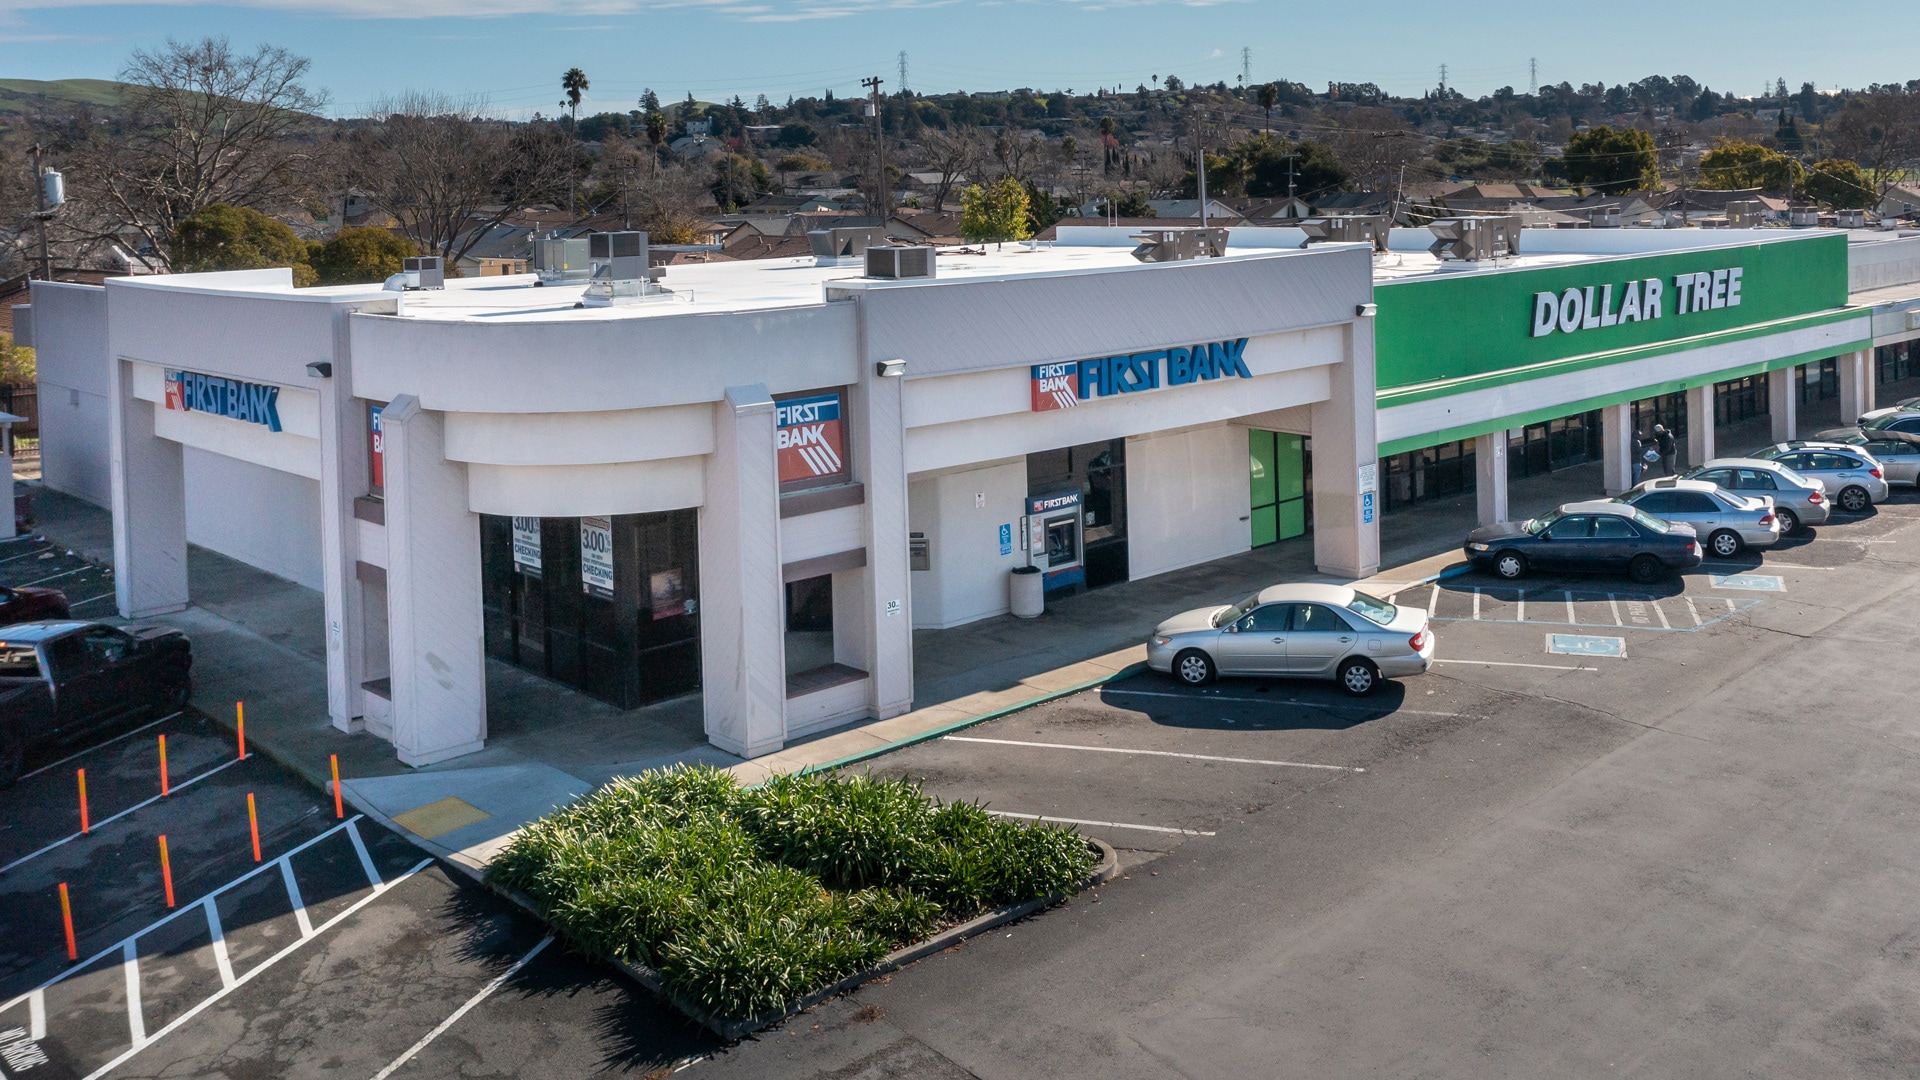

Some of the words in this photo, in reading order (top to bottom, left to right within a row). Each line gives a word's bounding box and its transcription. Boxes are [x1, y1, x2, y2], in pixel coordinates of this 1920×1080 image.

[1531, 278, 1664, 337] DOLLAR
[1673, 267, 1743, 314] TREE
[1039, 361, 1075, 378] FIRST
[1039, 376, 1073, 397] BANK
[776, 401, 836, 426] FIRST
[776, 423, 832, 456] BANK
[514, 543, 541, 560] CHECKING
[582, 563, 613, 580] CHECKING
[887, 600, 896, 610] 30
